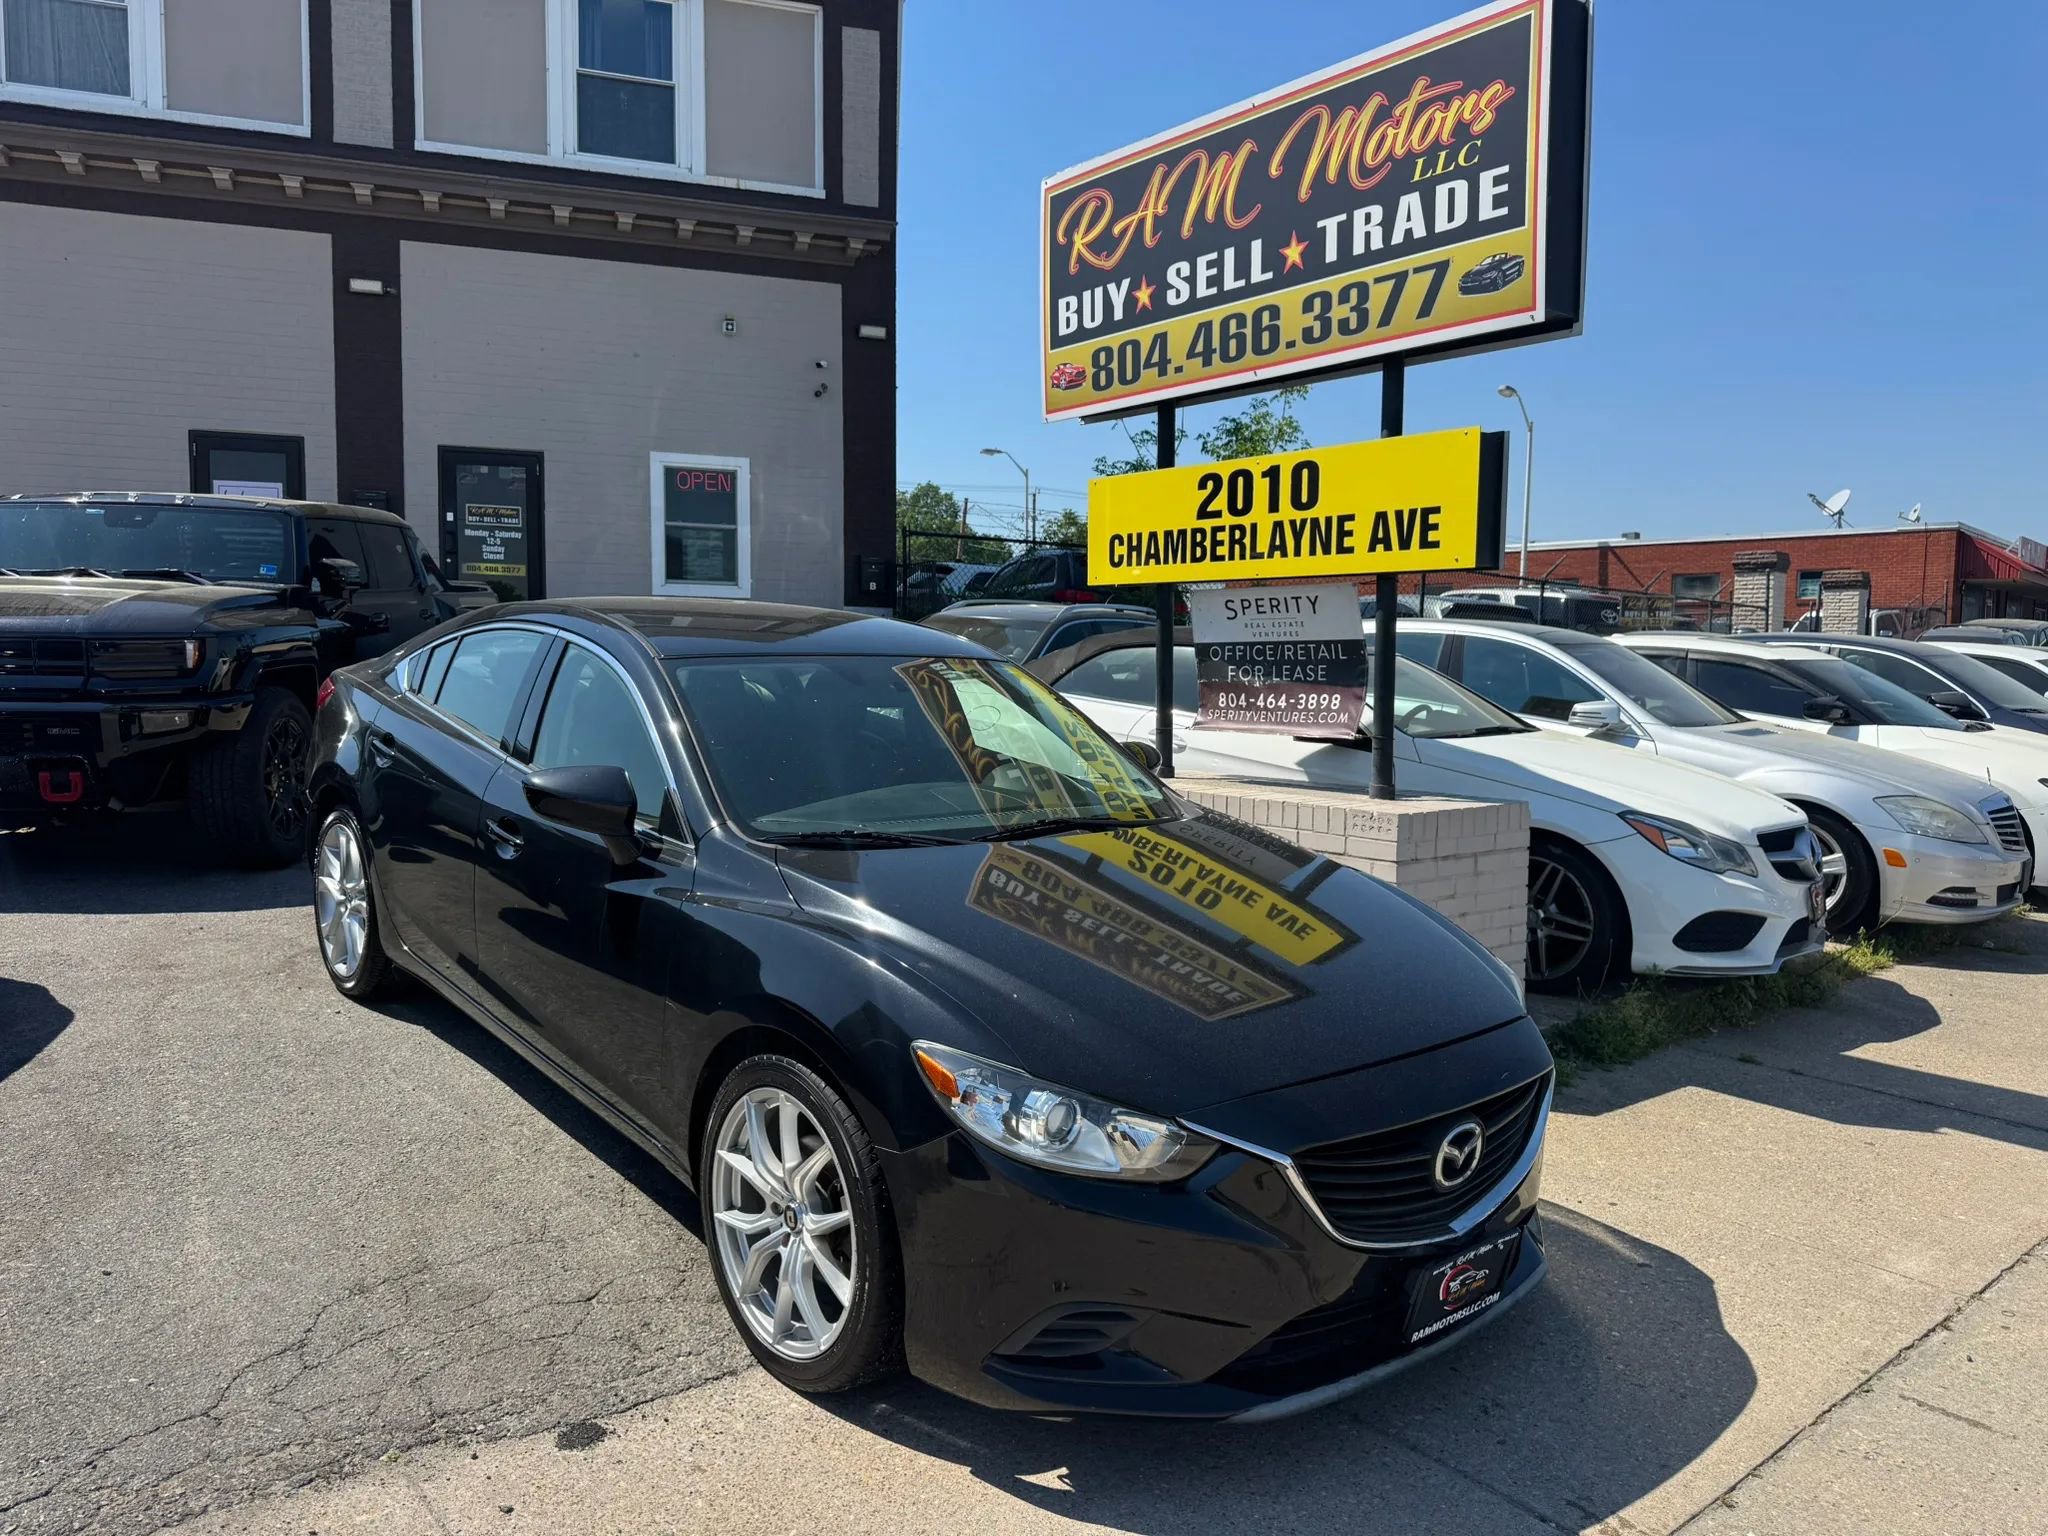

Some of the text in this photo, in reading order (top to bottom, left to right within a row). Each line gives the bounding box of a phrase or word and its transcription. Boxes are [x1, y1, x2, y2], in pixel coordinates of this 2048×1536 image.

[1410, 138, 1482, 183] LLC
[1057, 76, 1515, 275] RAM Motors
[1058, 163, 1510, 337] BUY SELL TRADE
[1091, 258, 1450, 392] 804.466.3377
[676, 471, 732, 492] OPEN
[1195, 459, 1320, 521] 2010
[464, 528, 490, 537] Monday
[494, 530, 522, 539] Saturday
[1108, 505, 1442, 569] CHAMBERLAYNE AVE
[482, 544, 505, 553] Sunday
[482, 552, 505, 560] Closed
[1224, 595, 1319, 621] SPERITY
[1244, 620, 1305, 629] REAL ESTATE
[1251, 630, 1300, 638] VENTURES
[1209, 643, 1348, 661] OFFICE/RETAIL
[1227, 665, 1327, 682] FOR LEASE
[1218, 692, 1341, 710] 804-464-3898
[1207, 709, 1349, 724] SPERITYVENTURES.COM
